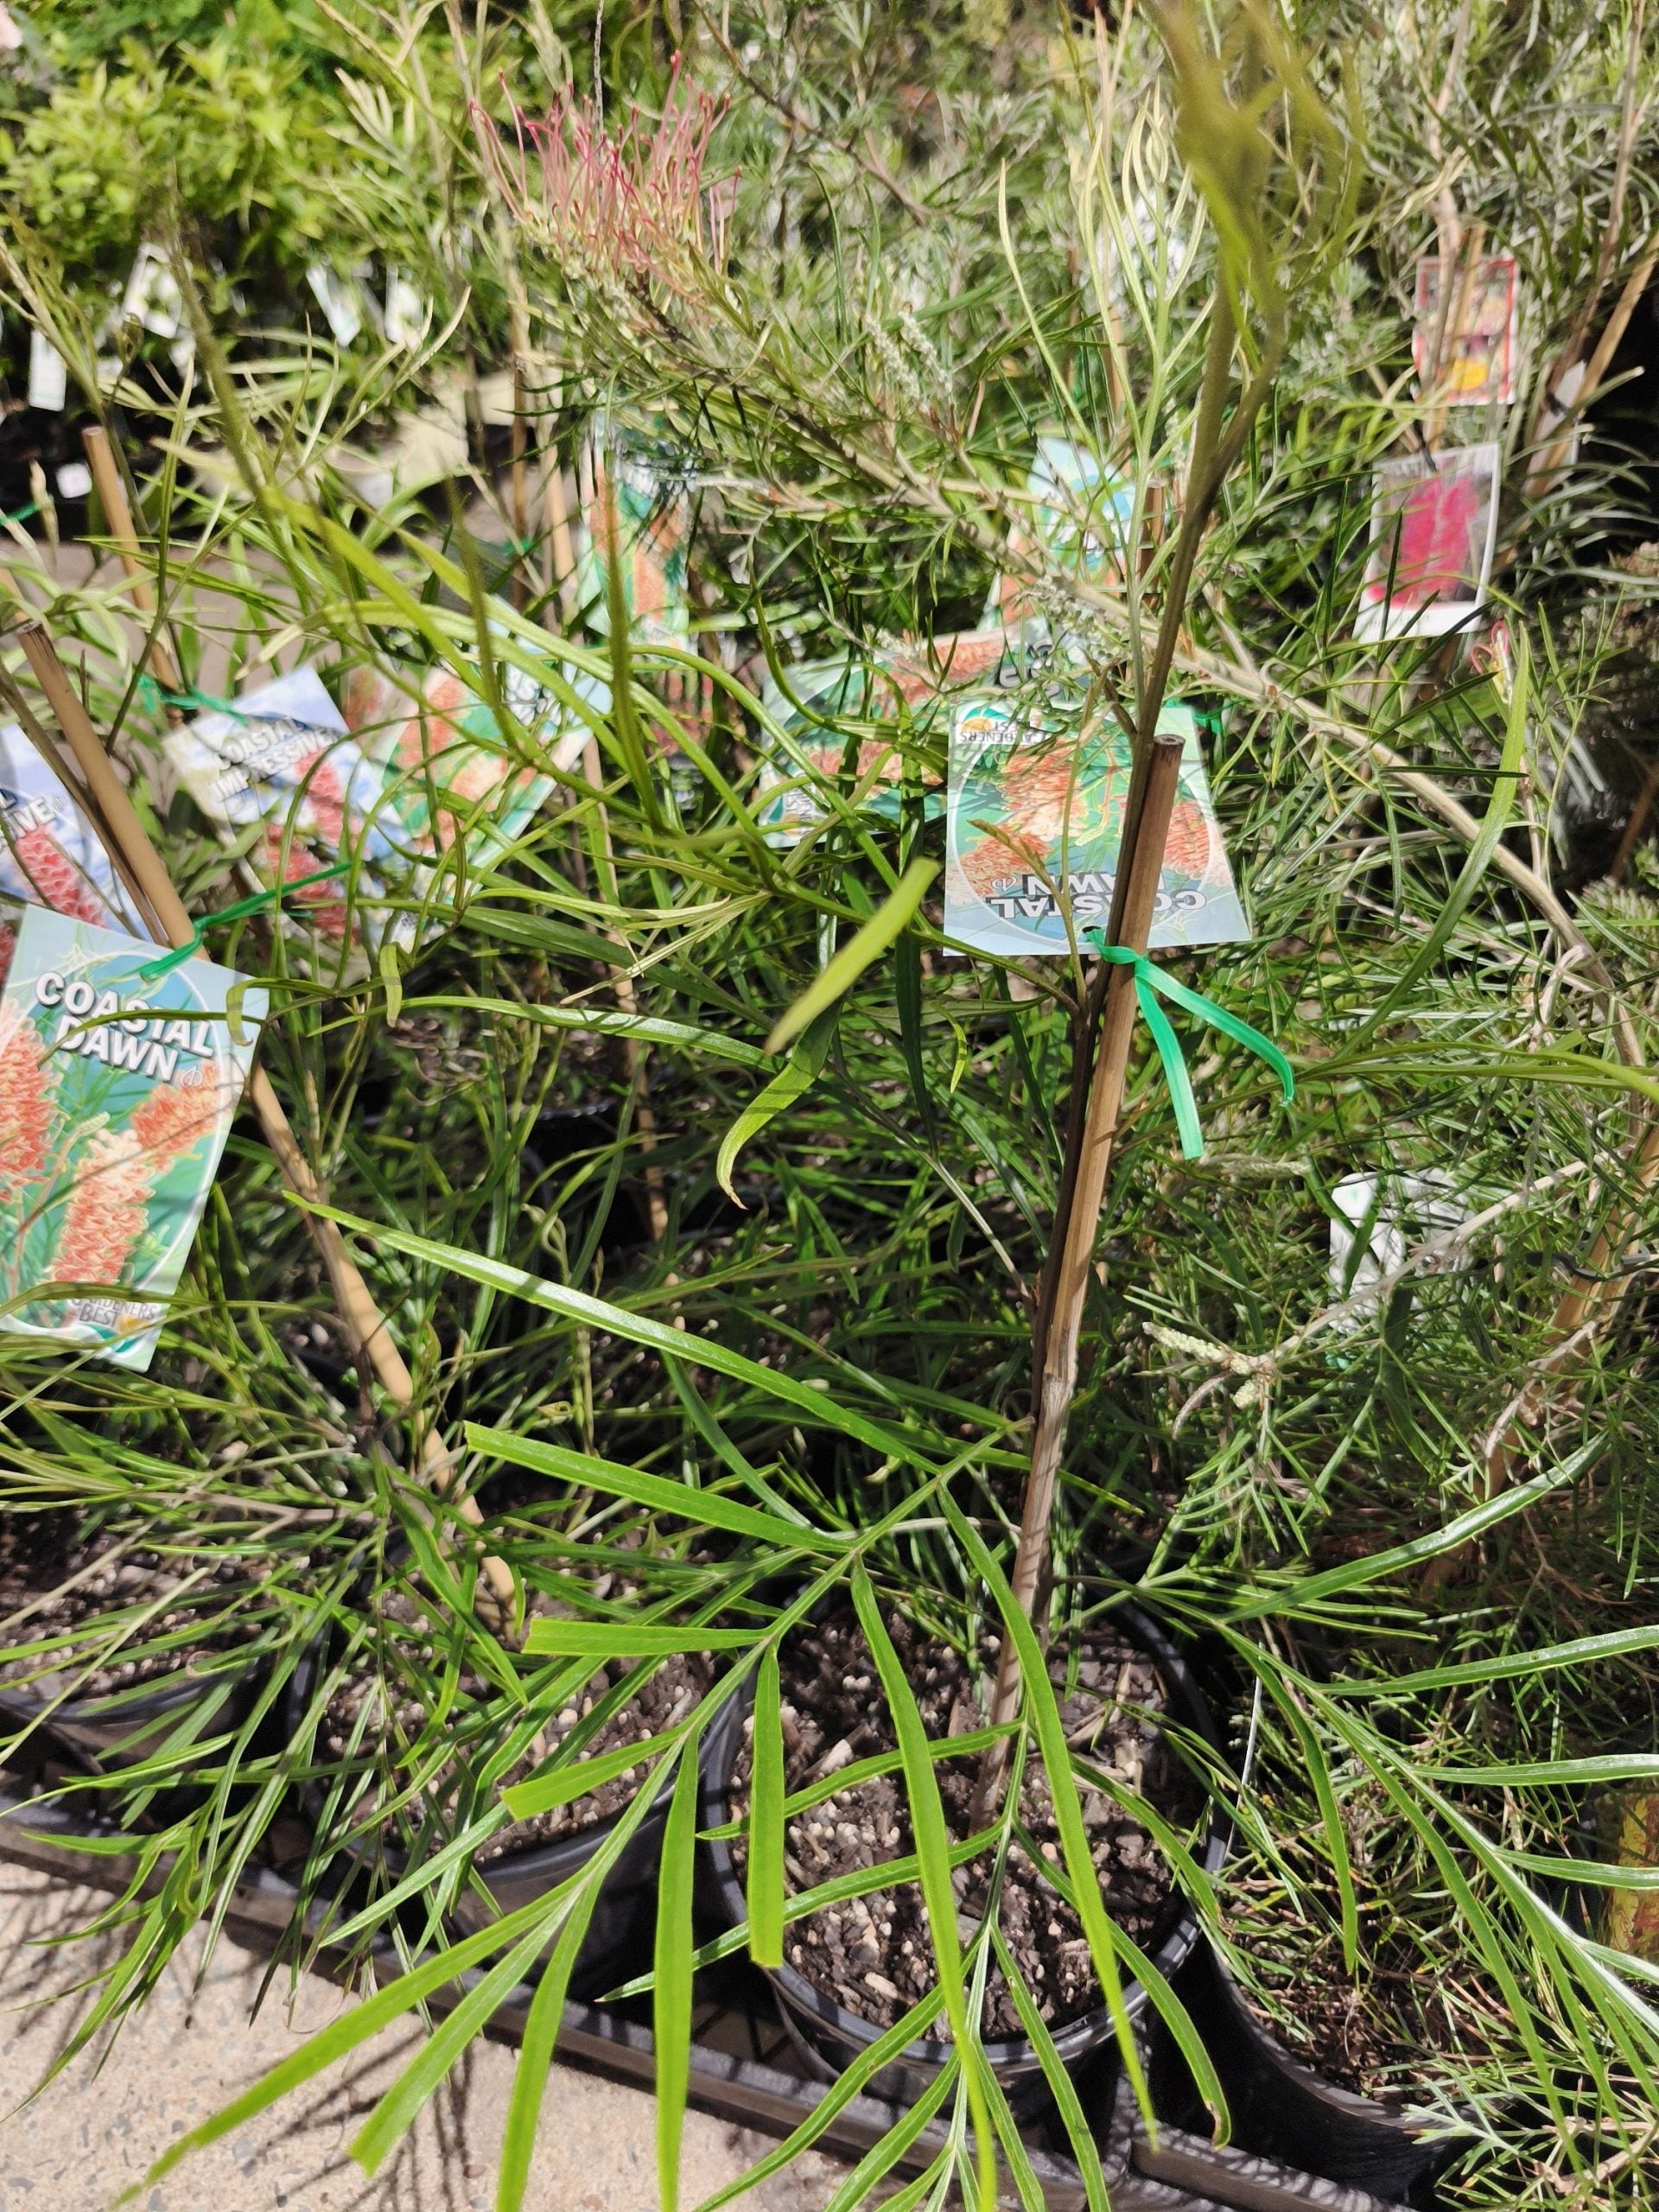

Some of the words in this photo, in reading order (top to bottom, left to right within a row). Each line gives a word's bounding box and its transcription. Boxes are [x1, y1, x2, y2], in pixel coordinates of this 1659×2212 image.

[36, 971, 214, 1058] COASTAL
[55, 1014, 180, 1082] DAWN
[79, 1303, 118, 1328] BEST
